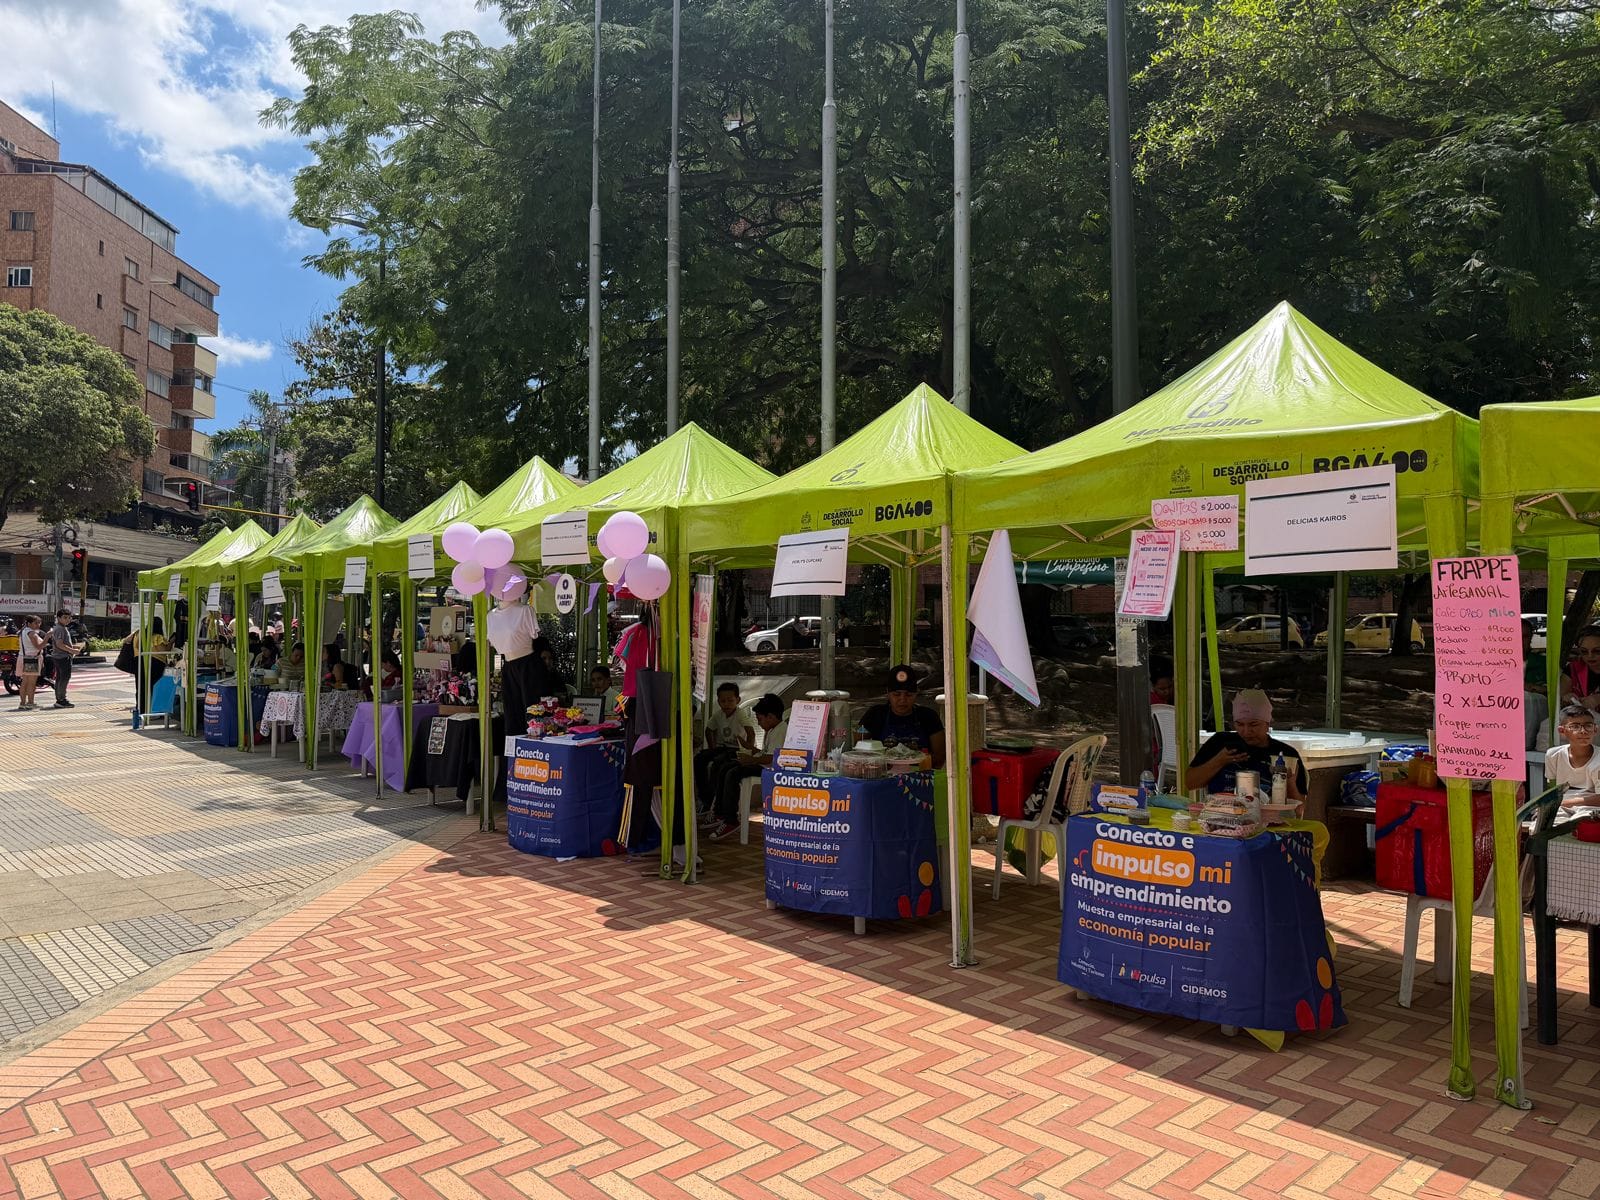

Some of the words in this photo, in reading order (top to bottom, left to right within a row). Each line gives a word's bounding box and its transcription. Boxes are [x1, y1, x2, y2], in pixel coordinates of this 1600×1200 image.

[1213, 461, 1290, 477] DESARROLLO
[823, 508, 864, 521] DESARROLLO
[875, 499, 933, 522] BGA400
[831, 518, 854, 526] SOCIAL
[1286, 516, 1319, 526] DELICIAS
[1319, 514, 1347, 523] KAIROS
[1437, 558, 1512, 581] FRAPPE
[1442, 692, 1454, 708] 2
[516, 746, 544, 760] Conecto
[545, 752, 550, 760] e
[516, 761, 548, 777] impulso
[550, 767, 562, 779] mi
[507, 779, 562, 796] emprendimiento
[774, 773, 819, 787] Conecto
[822, 779, 830, 788] e
[774, 790, 827, 811] impulso
[831, 794, 851, 812] mi
[530, 809, 554, 819] popular
[763, 816, 850, 834] emprendimiento
[766, 835, 785, 845] Muestra
[785, 840, 821, 850] empresarial
[832, 843, 840, 851] la
[1095, 822, 1176, 848] Conecto
[1181, 835, 1194, 849] e
[766, 846, 800, 860] economía
[802, 852, 839, 864] popular
[1096, 844, 1191, 879] impulso
[1200, 861, 1232, 884] mi
[820, 889, 849, 897] CIDEMOS
[1071, 871, 1232, 914] emprendimiento
[1077, 900, 1115, 919] Muestra
[1117, 912, 1182, 931] empresarial
[1185, 922, 1201, 933] de
[1204, 924, 1214, 935] la
[1078, 916, 1144, 942] economía
[1148, 932, 1212, 952] popular
[1181, 984, 1227, 999] CIDEMOS
